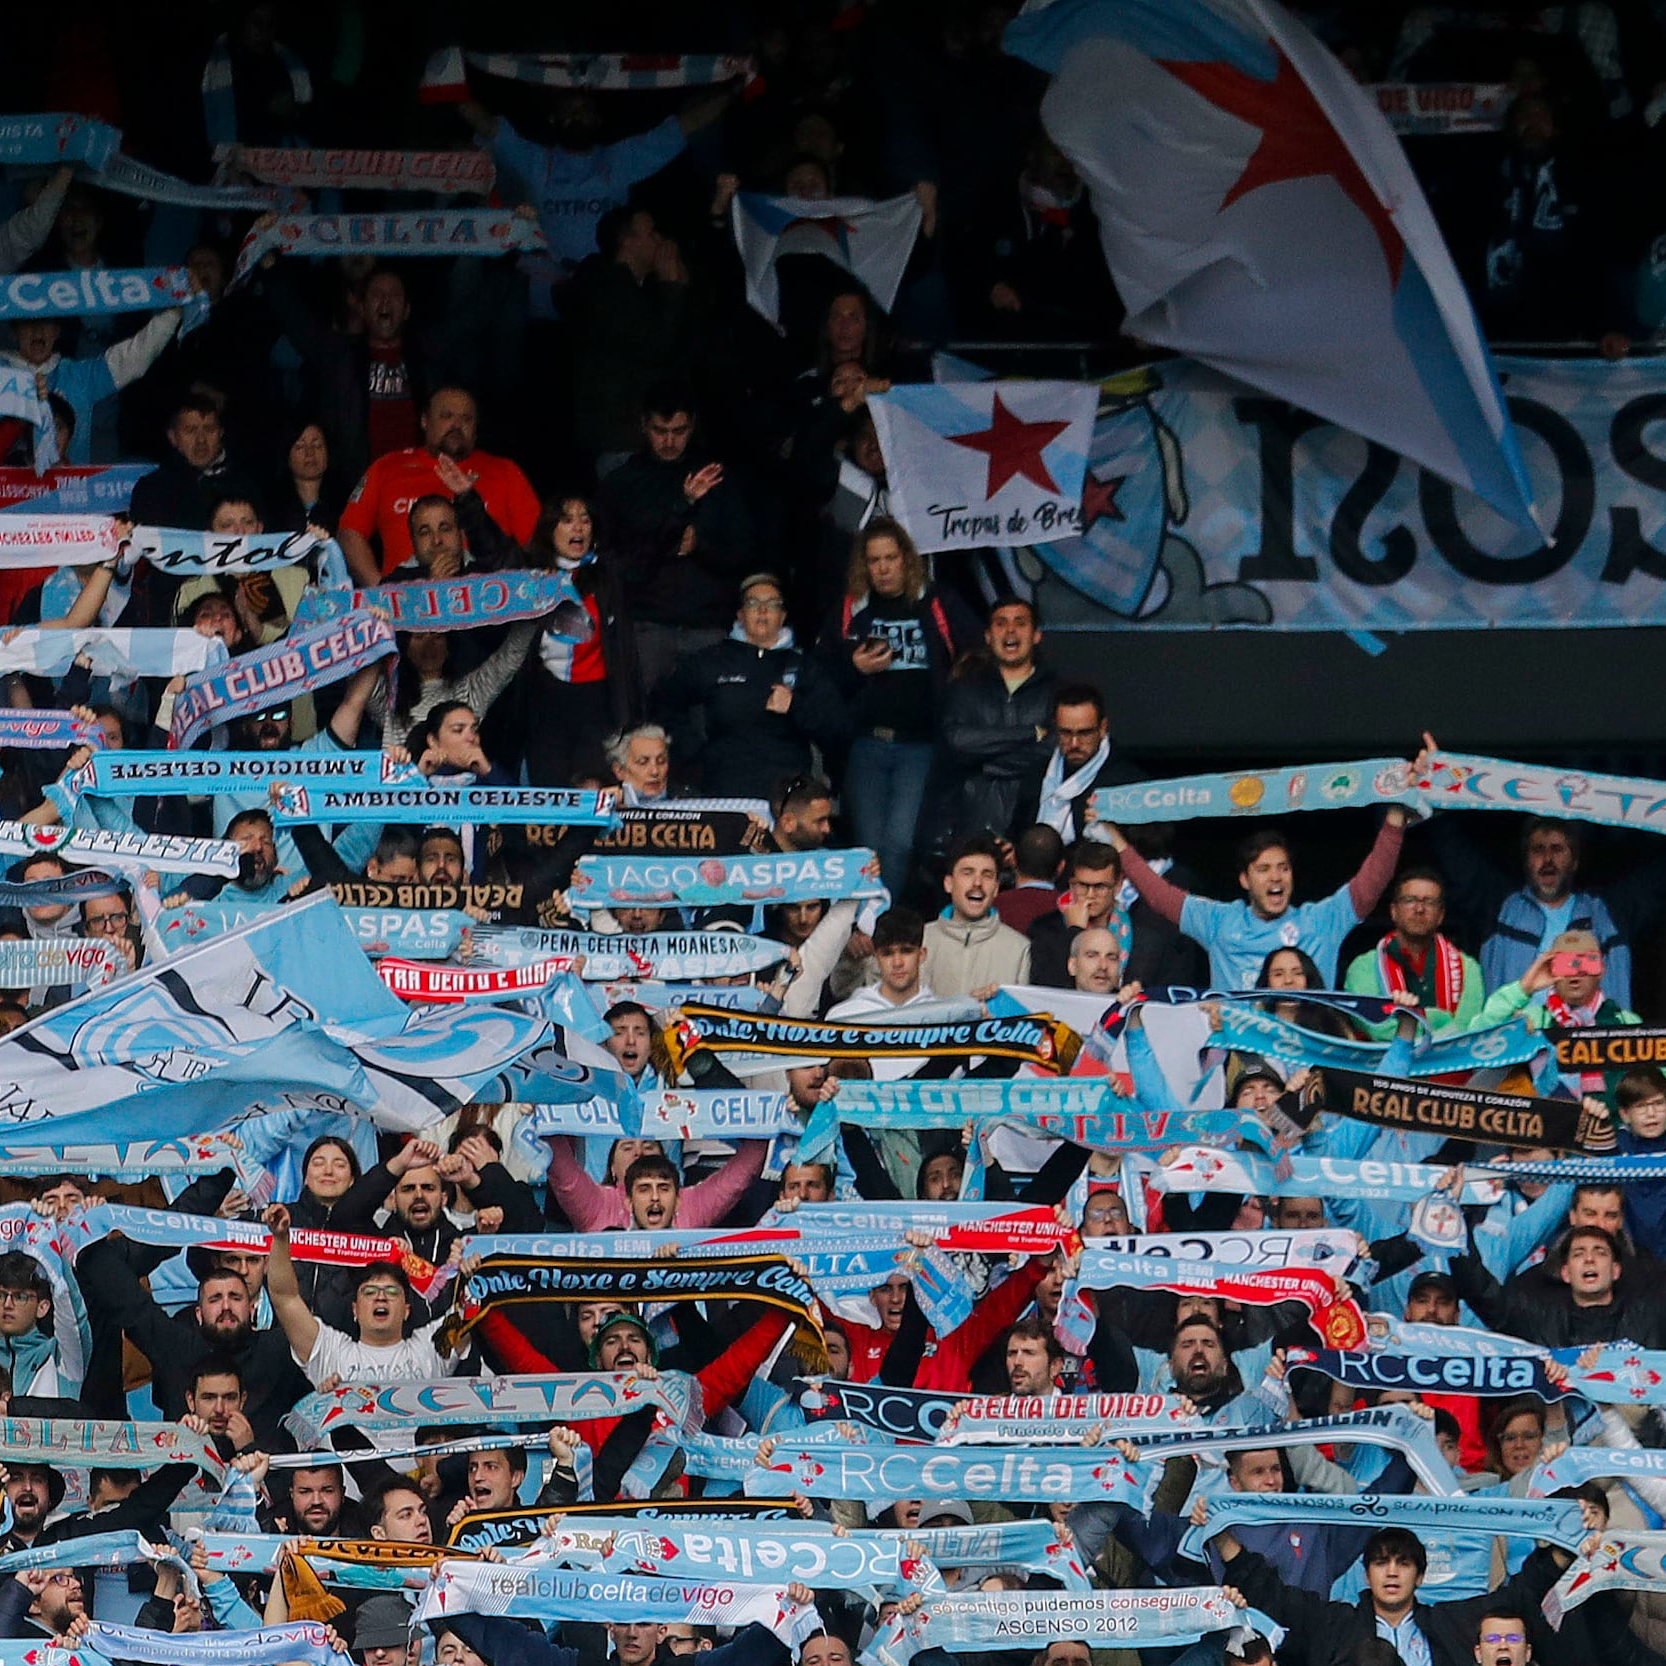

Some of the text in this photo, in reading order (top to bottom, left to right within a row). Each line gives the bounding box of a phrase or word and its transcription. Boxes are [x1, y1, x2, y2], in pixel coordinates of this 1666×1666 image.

[308, 217, 478, 245] CELTA
[109, 756, 365, 783] AMBICIÓN CELESTE
[324, 789, 582, 809] AMBICIÓN CELESTE
[75, 828, 240, 862] CELESTE
[651, 822, 715, 851] CELTA
[732, 858, 844, 886] ASPAS
[587, 934, 662, 954] CELTISTA
[980, 1016, 1043, 1046] Celta
[1606, 1037, 1666, 1063] CLUB
[1354, 1087, 1545, 1138] REAL CLUB CELTA
[227, 1234, 393, 1254] FINAL UNITED
[529, 1266, 603, 1292] Noxe
[629, 1265, 732, 1292] Sempre
[1176, 1271, 1294, 1292] FINAL MANCHESTER
[1339, 1349, 1534, 1388] RCCelta
[376, 1376, 617, 1417] CELTA
[965, 1393, 1165, 1420] CELTA DE VIGO
[840, 1453, 1073, 1496] RCCelta
[682, 1533, 901, 1580] RCCelta
[489, 1573, 734, 1608] realclubceltadevigo
[953, 1592, 1198, 1617] contigo puidemos conseguilo
[995, 1617, 1139, 1636] ASCENSO 2012
